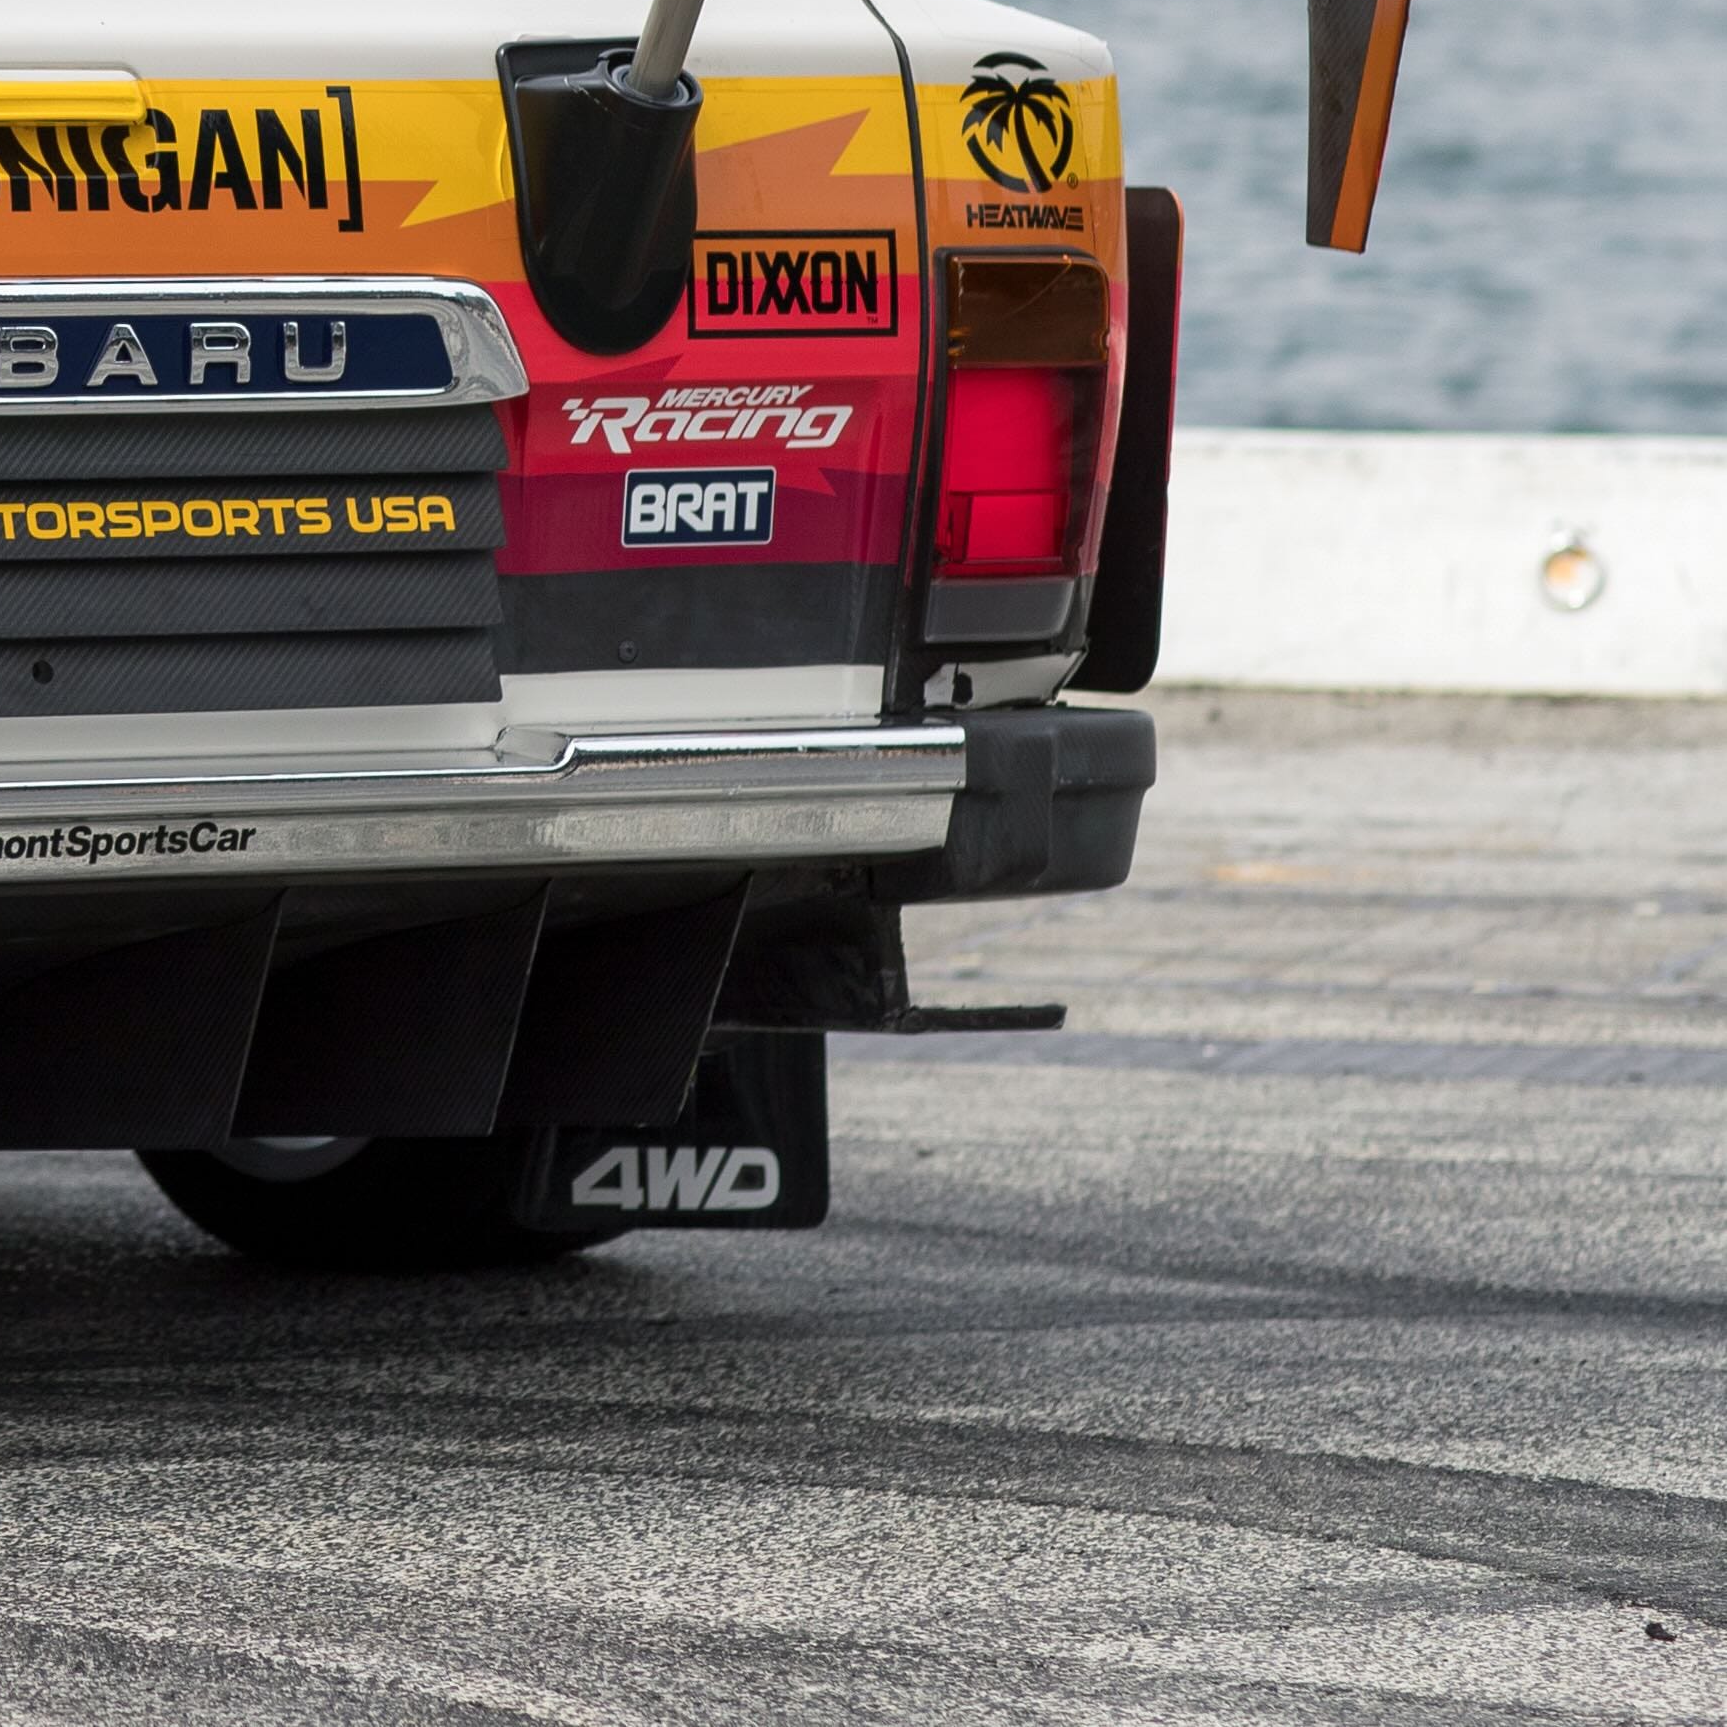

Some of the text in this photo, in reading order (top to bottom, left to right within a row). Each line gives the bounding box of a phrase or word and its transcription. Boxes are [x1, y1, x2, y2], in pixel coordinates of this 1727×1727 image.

[706, 249, 879, 316] DIXXON
[568, 396, 854, 454] Racing
[656, 384, 814, 409] MERCURY
[346, 495, 457, 534] USA
[627, 479, 771, 535] BRAT
[571, 1146, 781, 1211] 4WD
